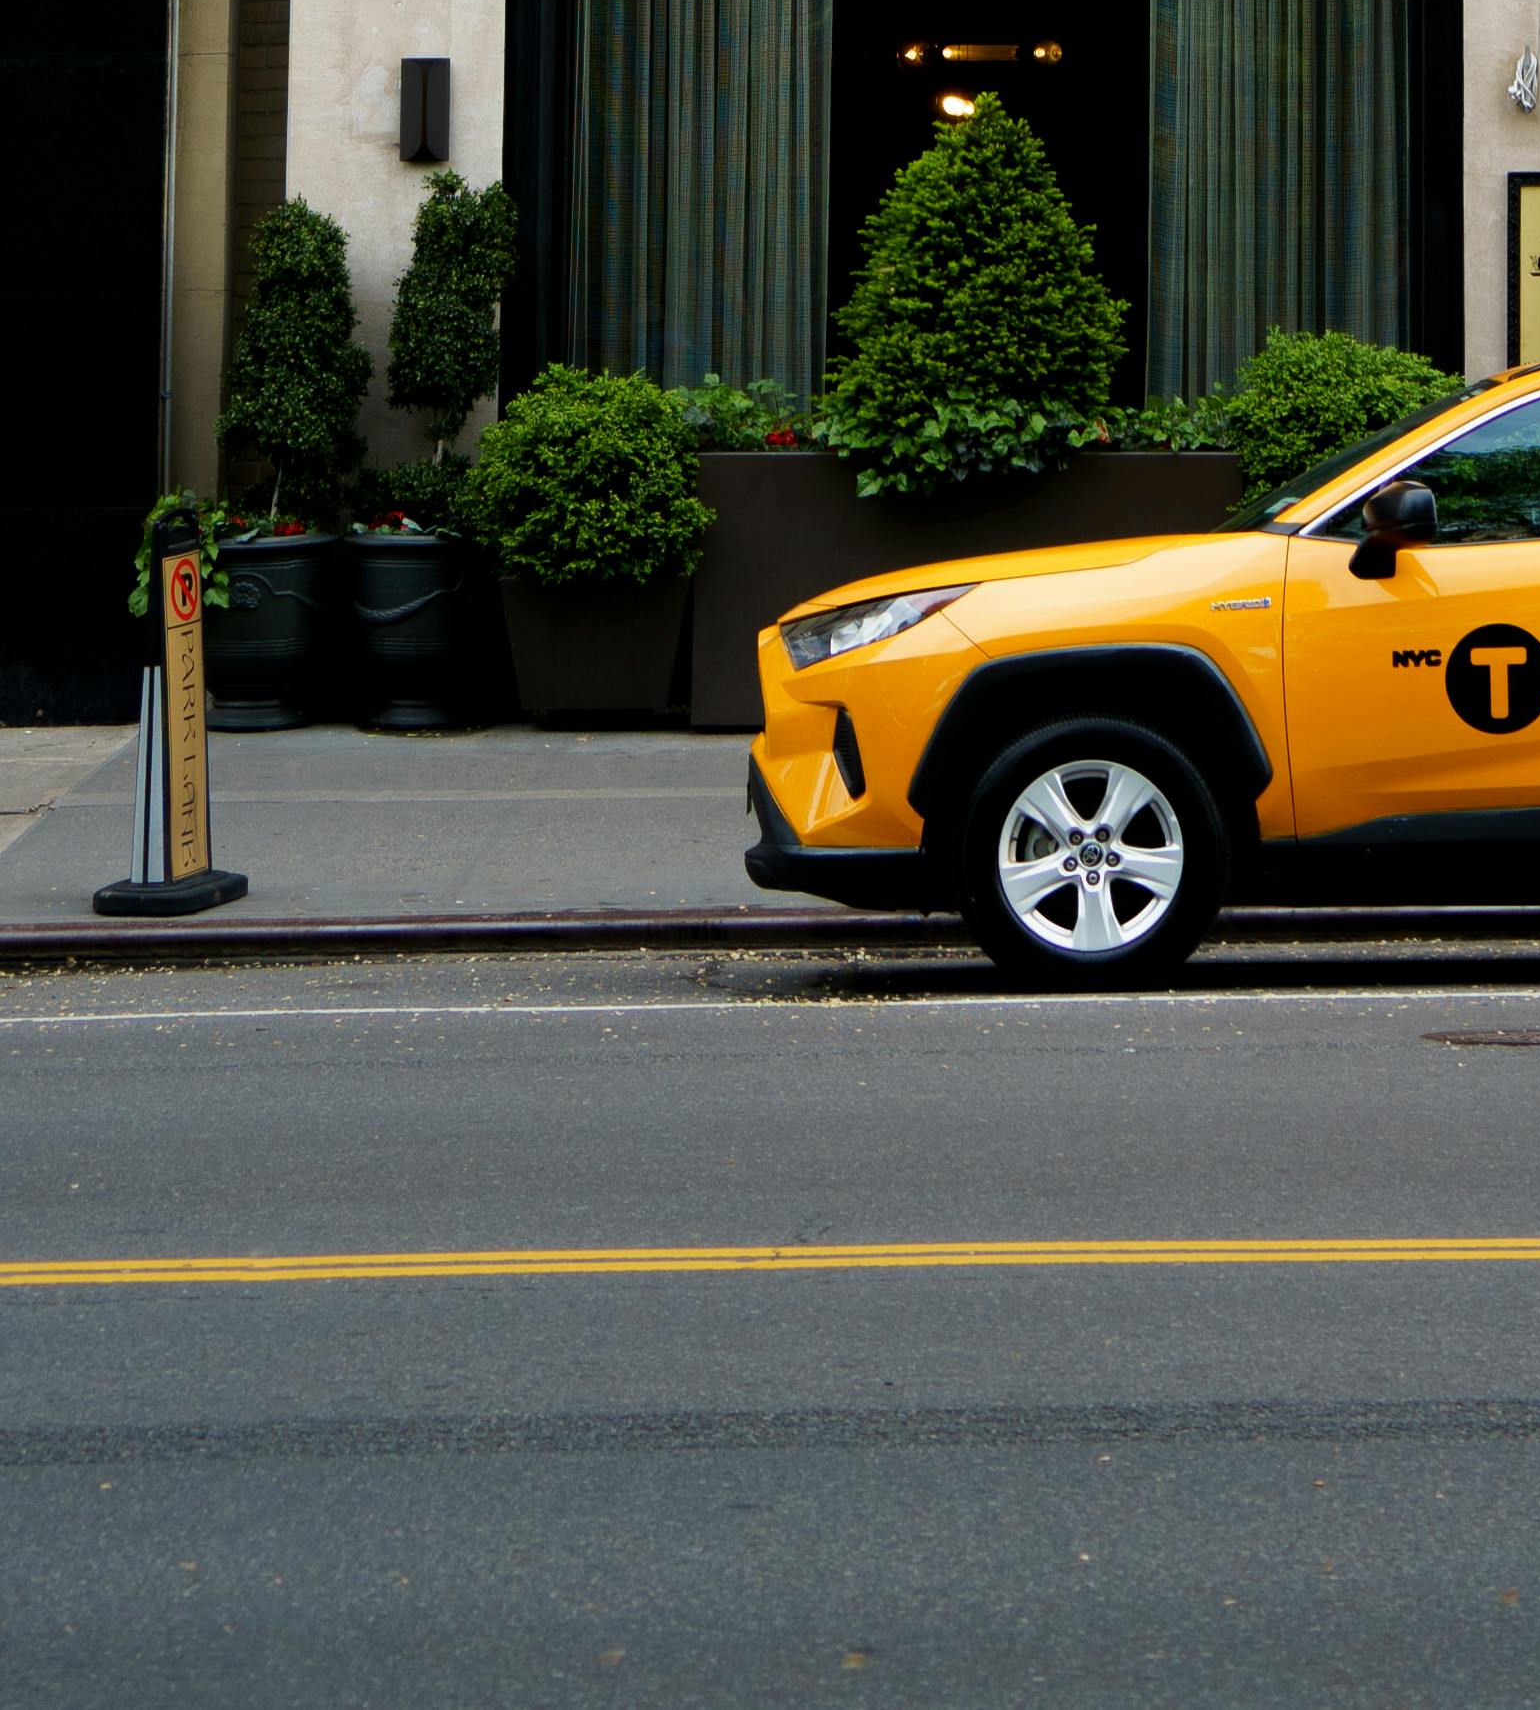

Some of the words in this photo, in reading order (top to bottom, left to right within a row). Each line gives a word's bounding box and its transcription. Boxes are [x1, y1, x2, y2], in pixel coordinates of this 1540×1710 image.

[180, 629, 196, 742] PARK
[1392, 649, 1442, 668] NYC
[181, 754, 197, 868] LANE
